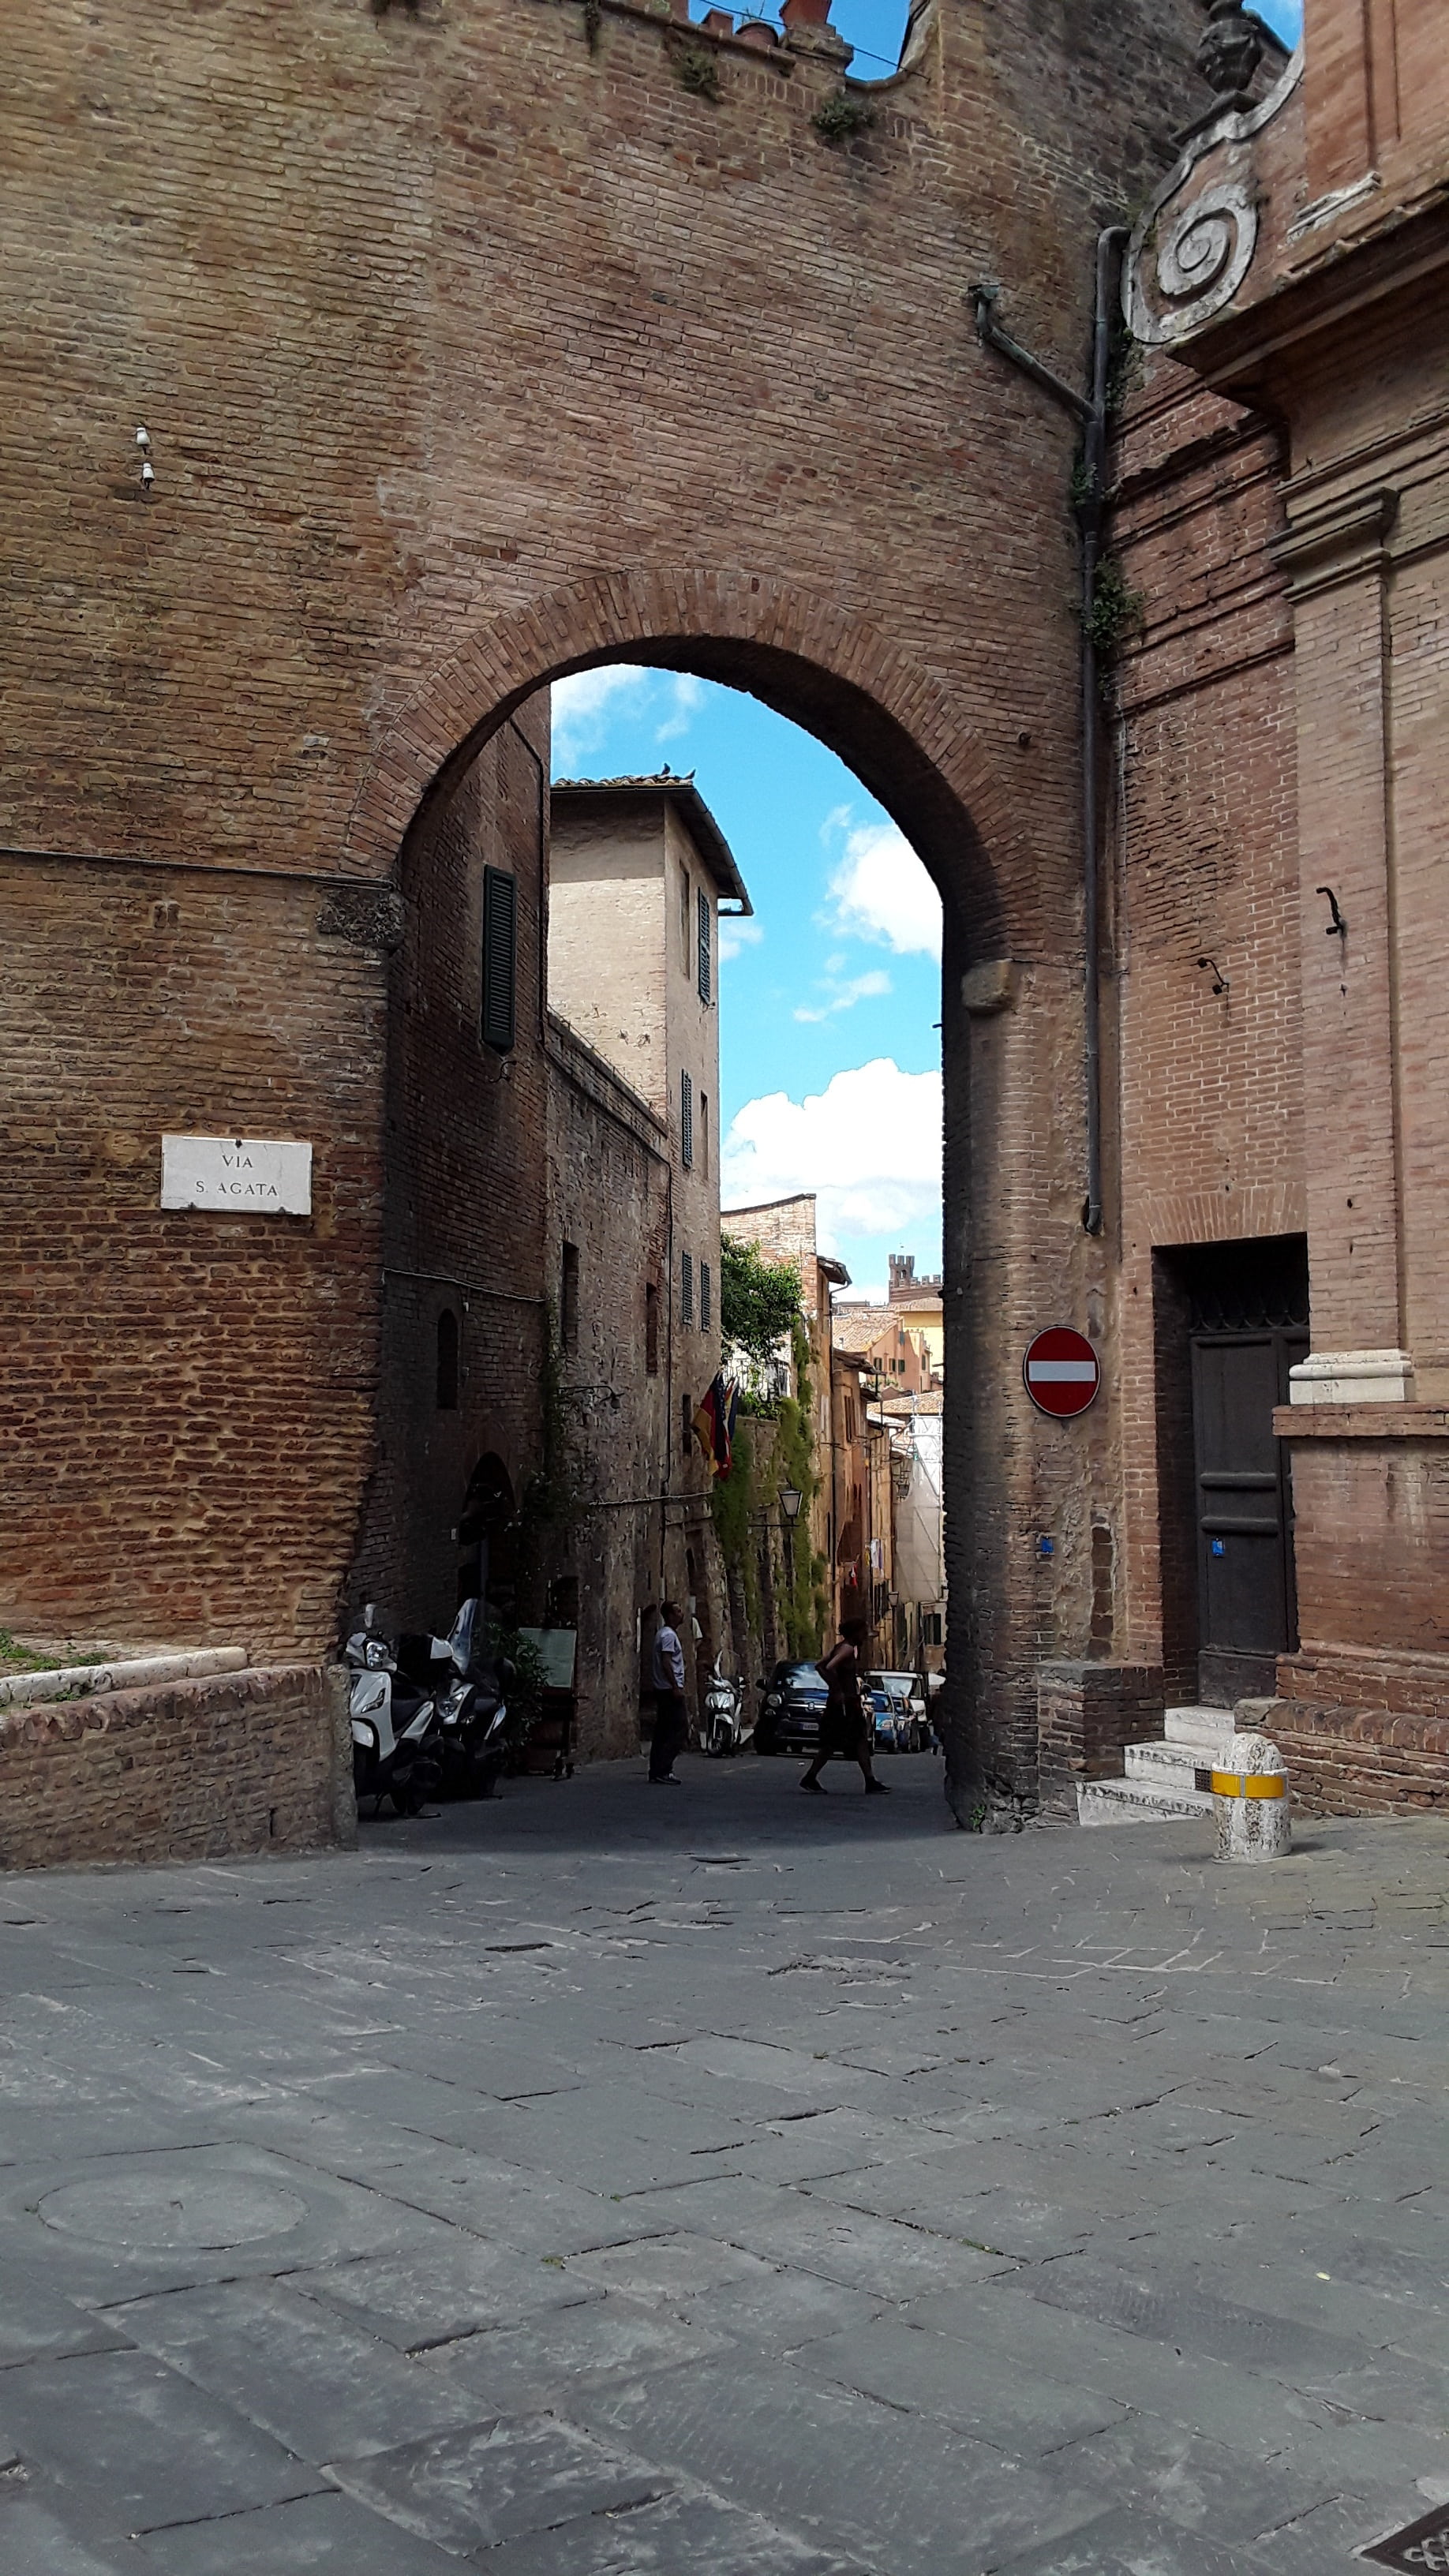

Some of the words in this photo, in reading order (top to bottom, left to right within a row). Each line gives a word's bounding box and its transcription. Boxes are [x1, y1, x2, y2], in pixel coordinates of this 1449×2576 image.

[222, 1155, 253, 1168] VIA
[196, 1180, 208, 1193] S.
[216, 1182, 278, 1196] AGATA
